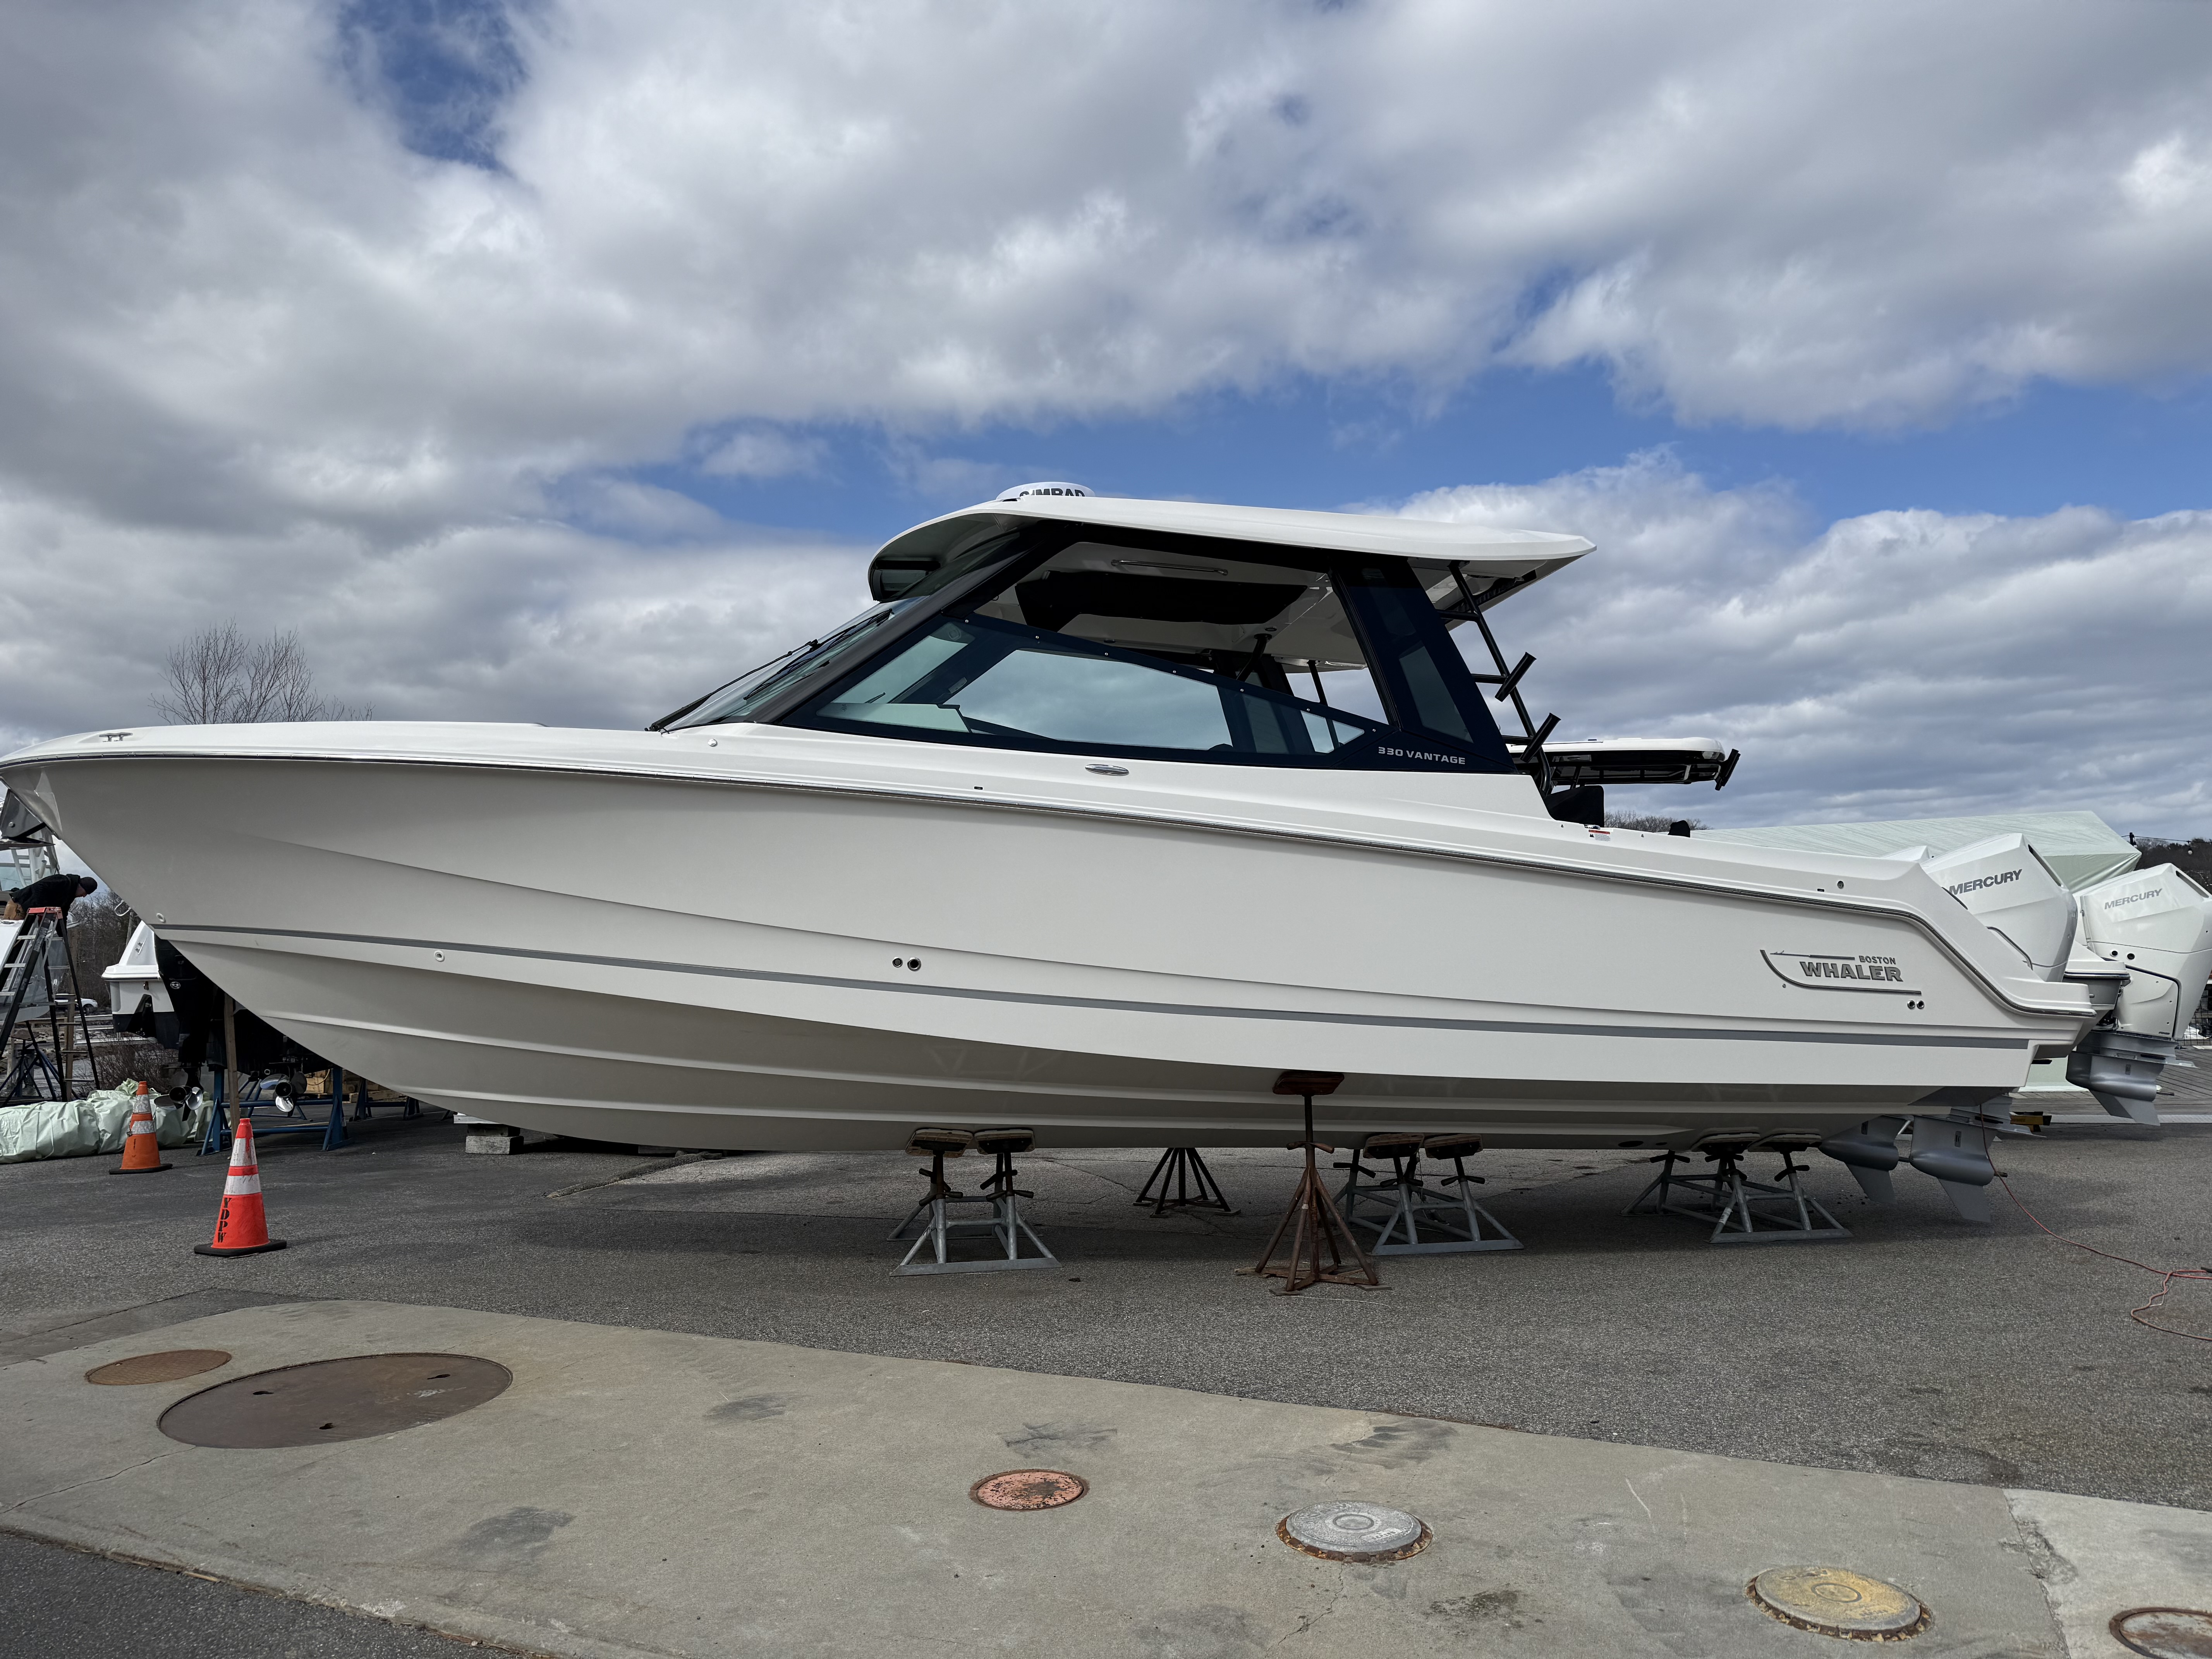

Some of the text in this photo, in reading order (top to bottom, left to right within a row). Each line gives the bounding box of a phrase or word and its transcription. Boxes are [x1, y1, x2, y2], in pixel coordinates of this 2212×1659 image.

[1378, 747, 1465, 765] 330 VANTAGE
[1949, 869, 2022, 895] MERCURY
[2104, 888, 2162, 910] MERCURY
[1859, 955, 1896, 965] BOSTON
[1799, 962, 1903, 982] WHALER
